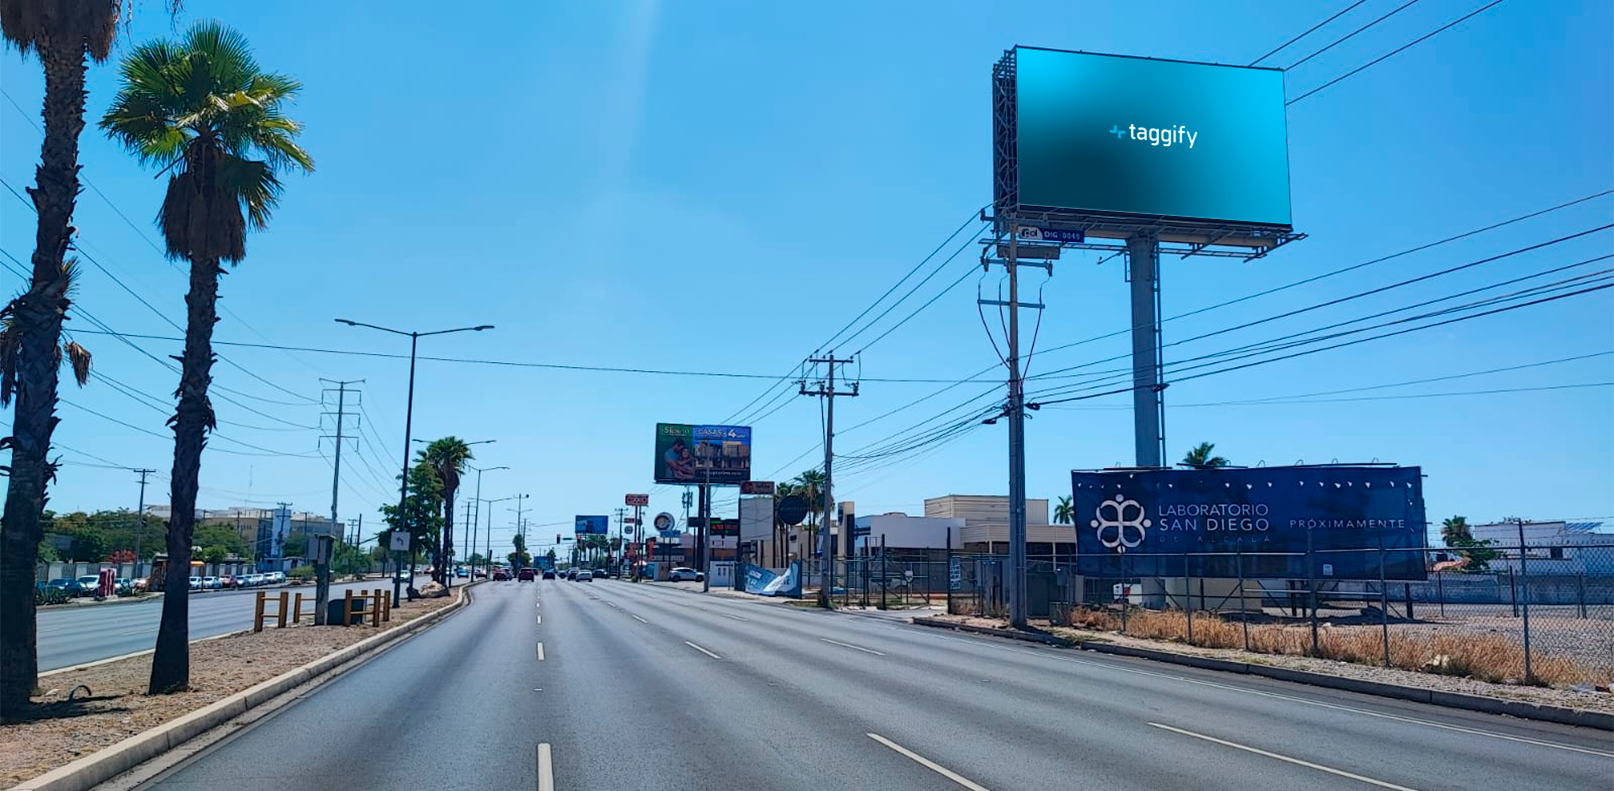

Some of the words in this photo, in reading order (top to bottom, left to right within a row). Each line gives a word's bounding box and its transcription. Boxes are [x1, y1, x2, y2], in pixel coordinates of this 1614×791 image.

[1128, 123, 1198, 149] taggify
[1044, 230, 1058, 239] DIG
[1158, 503, 1269, 517] LABORATORIO
[1159, 518, 1197, 532] SAN
[1206, 518, 1270, 532] DIEGO
[1289, 517, 1405, 529] PRÓXIMAMENTE
[1160, 535, 1179, 543] DE
